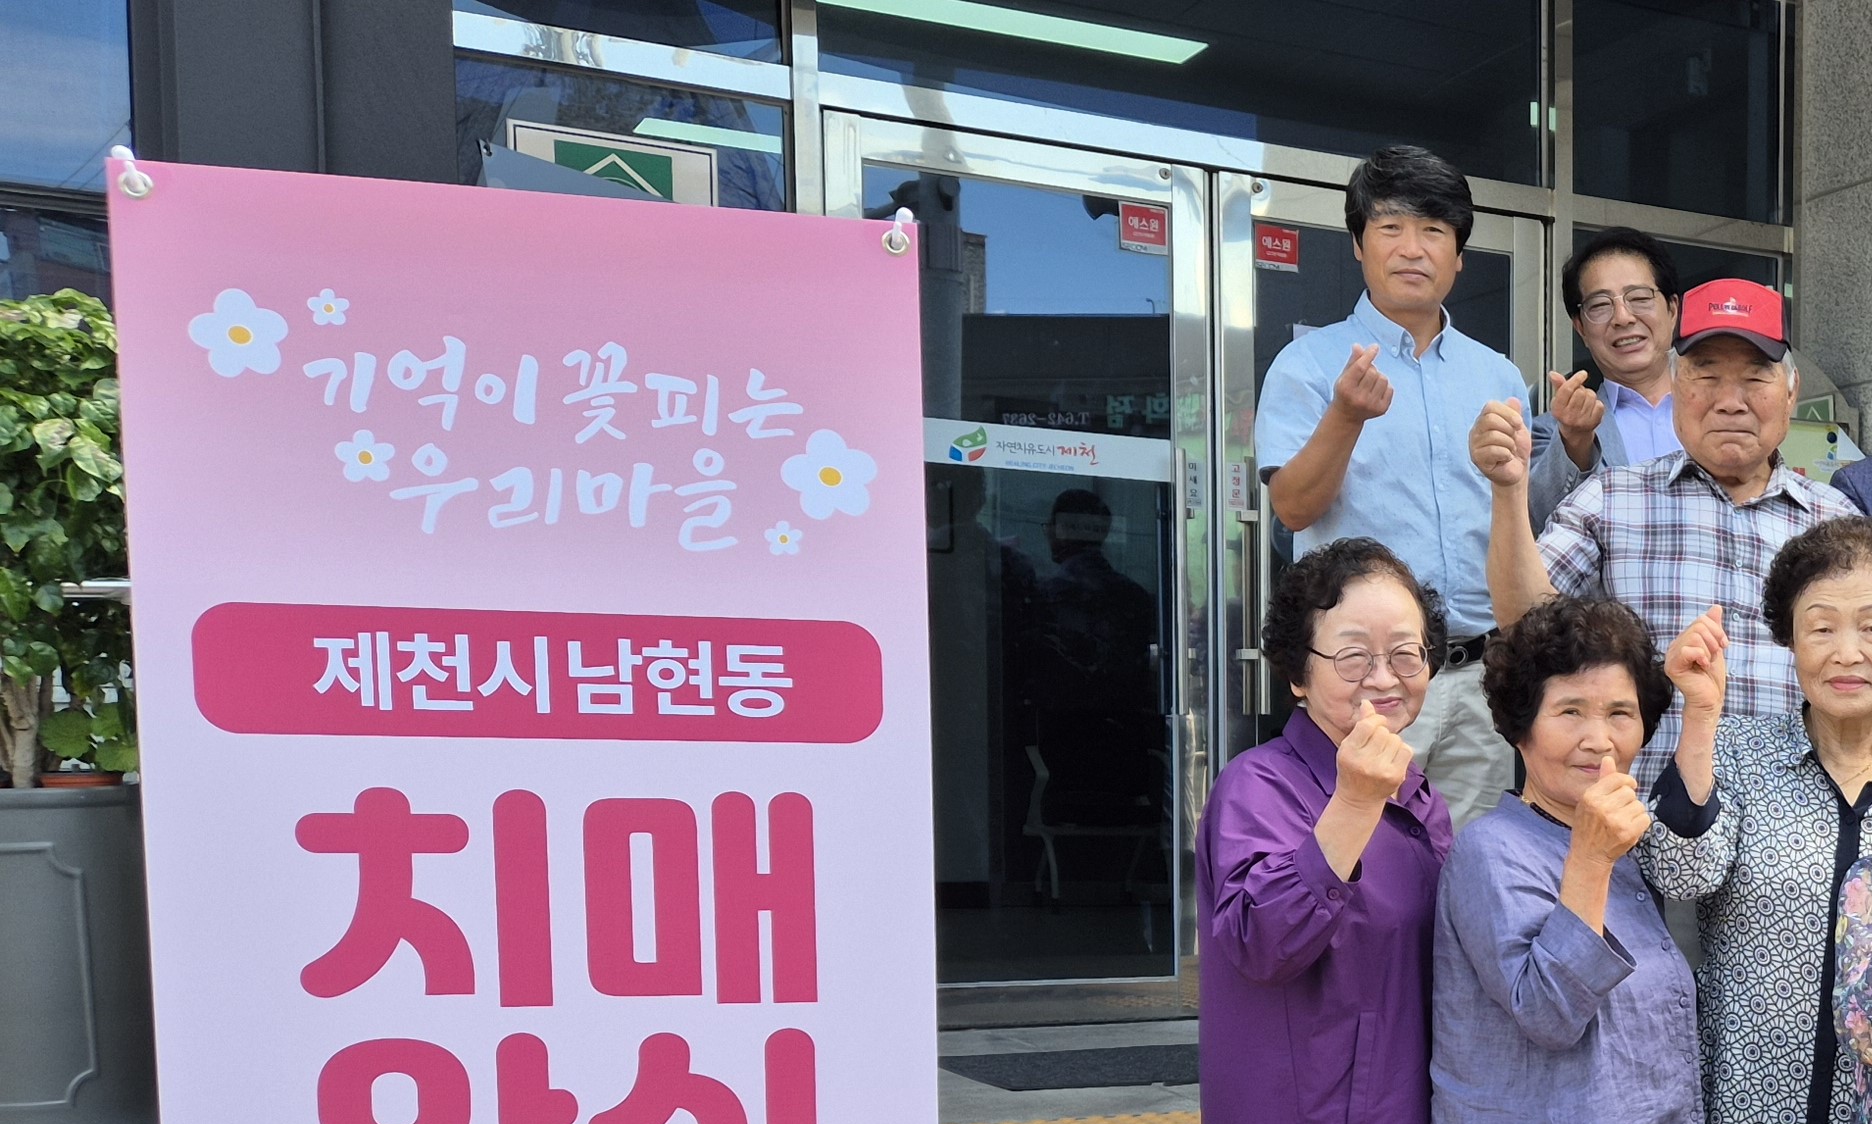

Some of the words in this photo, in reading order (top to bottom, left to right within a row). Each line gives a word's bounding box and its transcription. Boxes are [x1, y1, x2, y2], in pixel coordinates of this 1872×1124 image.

[1128, 216, 1160, 232] 에스원
[1261, 236, 1291, 252] 에스원
[303, 336, 539, 430] 기억이
[996, 440, 1056, 457] 자연치유도시
[1057, 441, 1099, 465] 제천
[1188, 462, 1198, 498] 미세요
[1232, 464, 1241, 498] 고정문
[313, 630, 551, 714] 제천시
[568, 637, 793, 718] 남현동
[295, 786, 818, 1007] 치매
